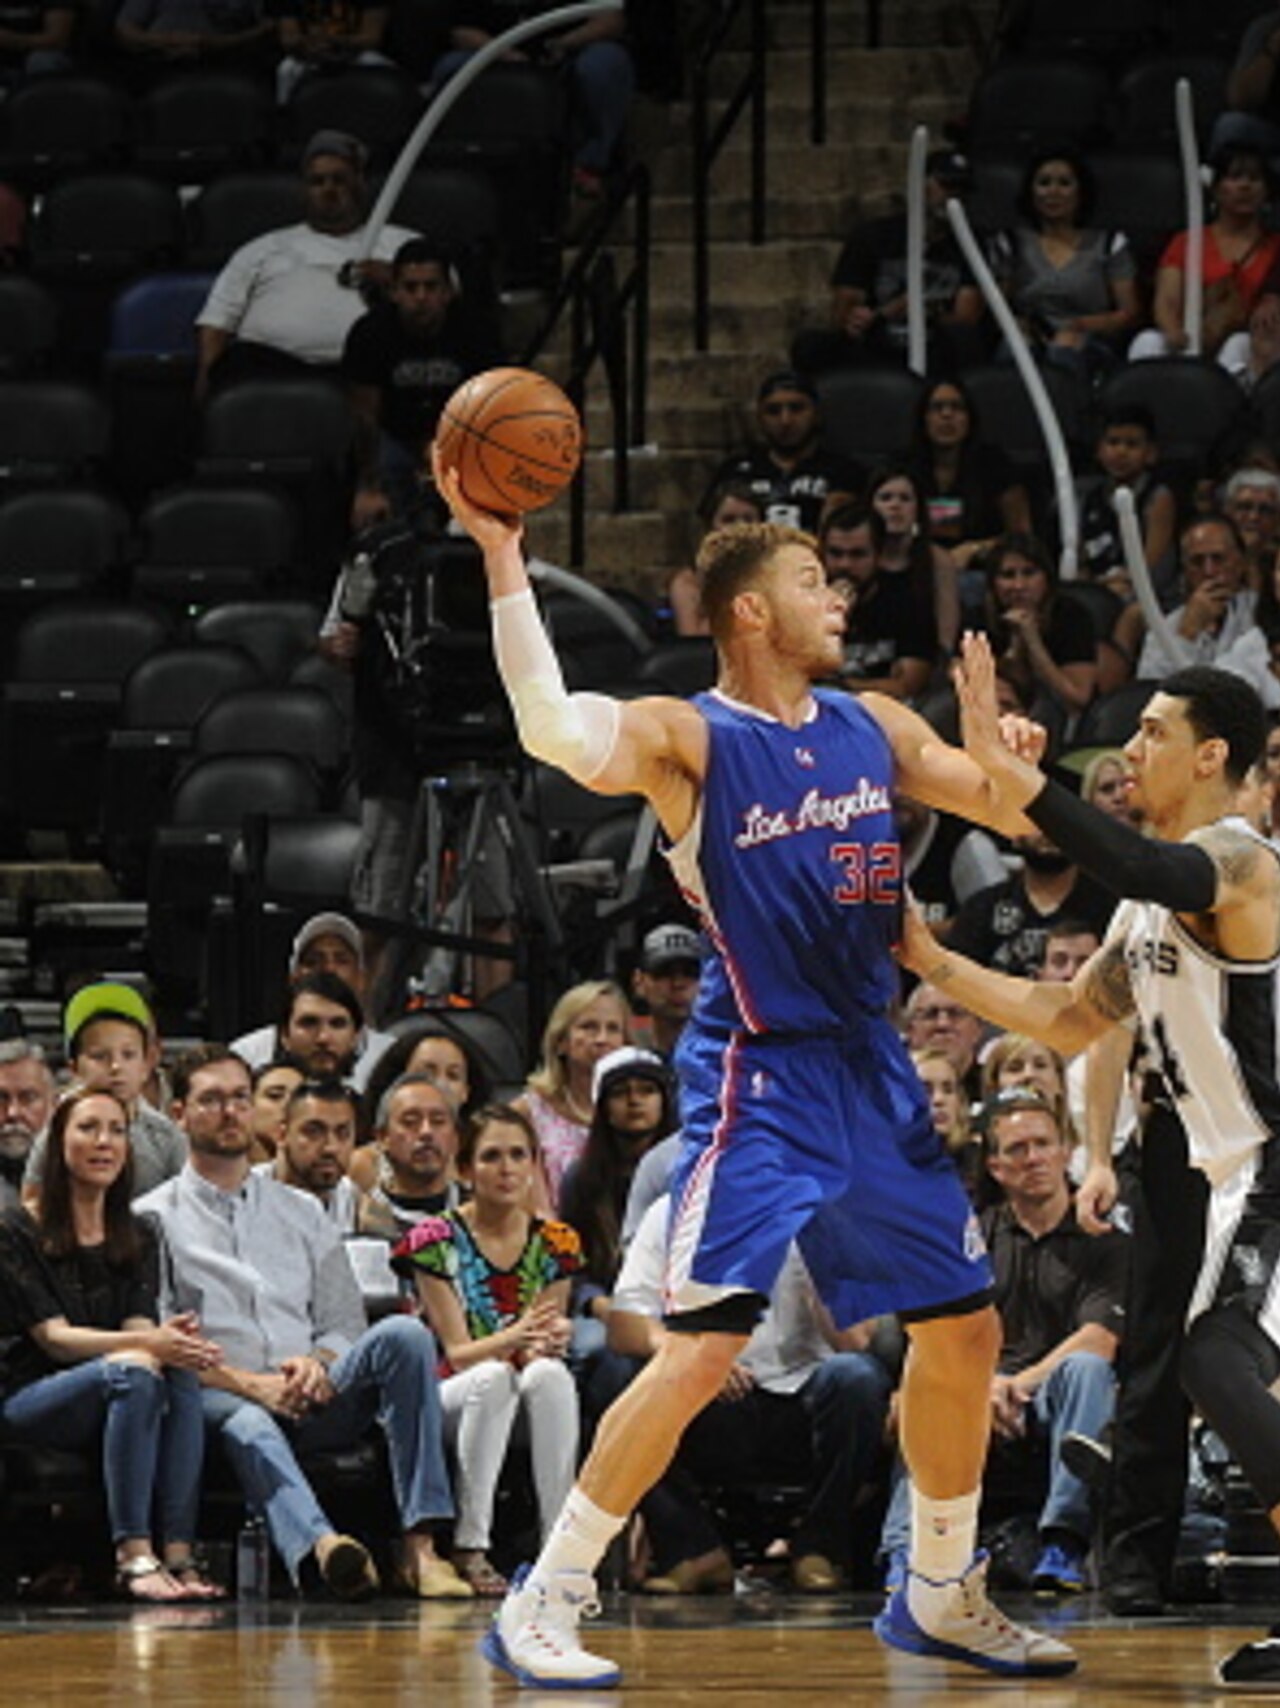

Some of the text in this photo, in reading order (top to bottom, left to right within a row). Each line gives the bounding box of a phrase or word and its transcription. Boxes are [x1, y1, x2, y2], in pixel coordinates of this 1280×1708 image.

[734, 776, 892, 850] Los Angeles
[829, 842, 901, 905] 32
